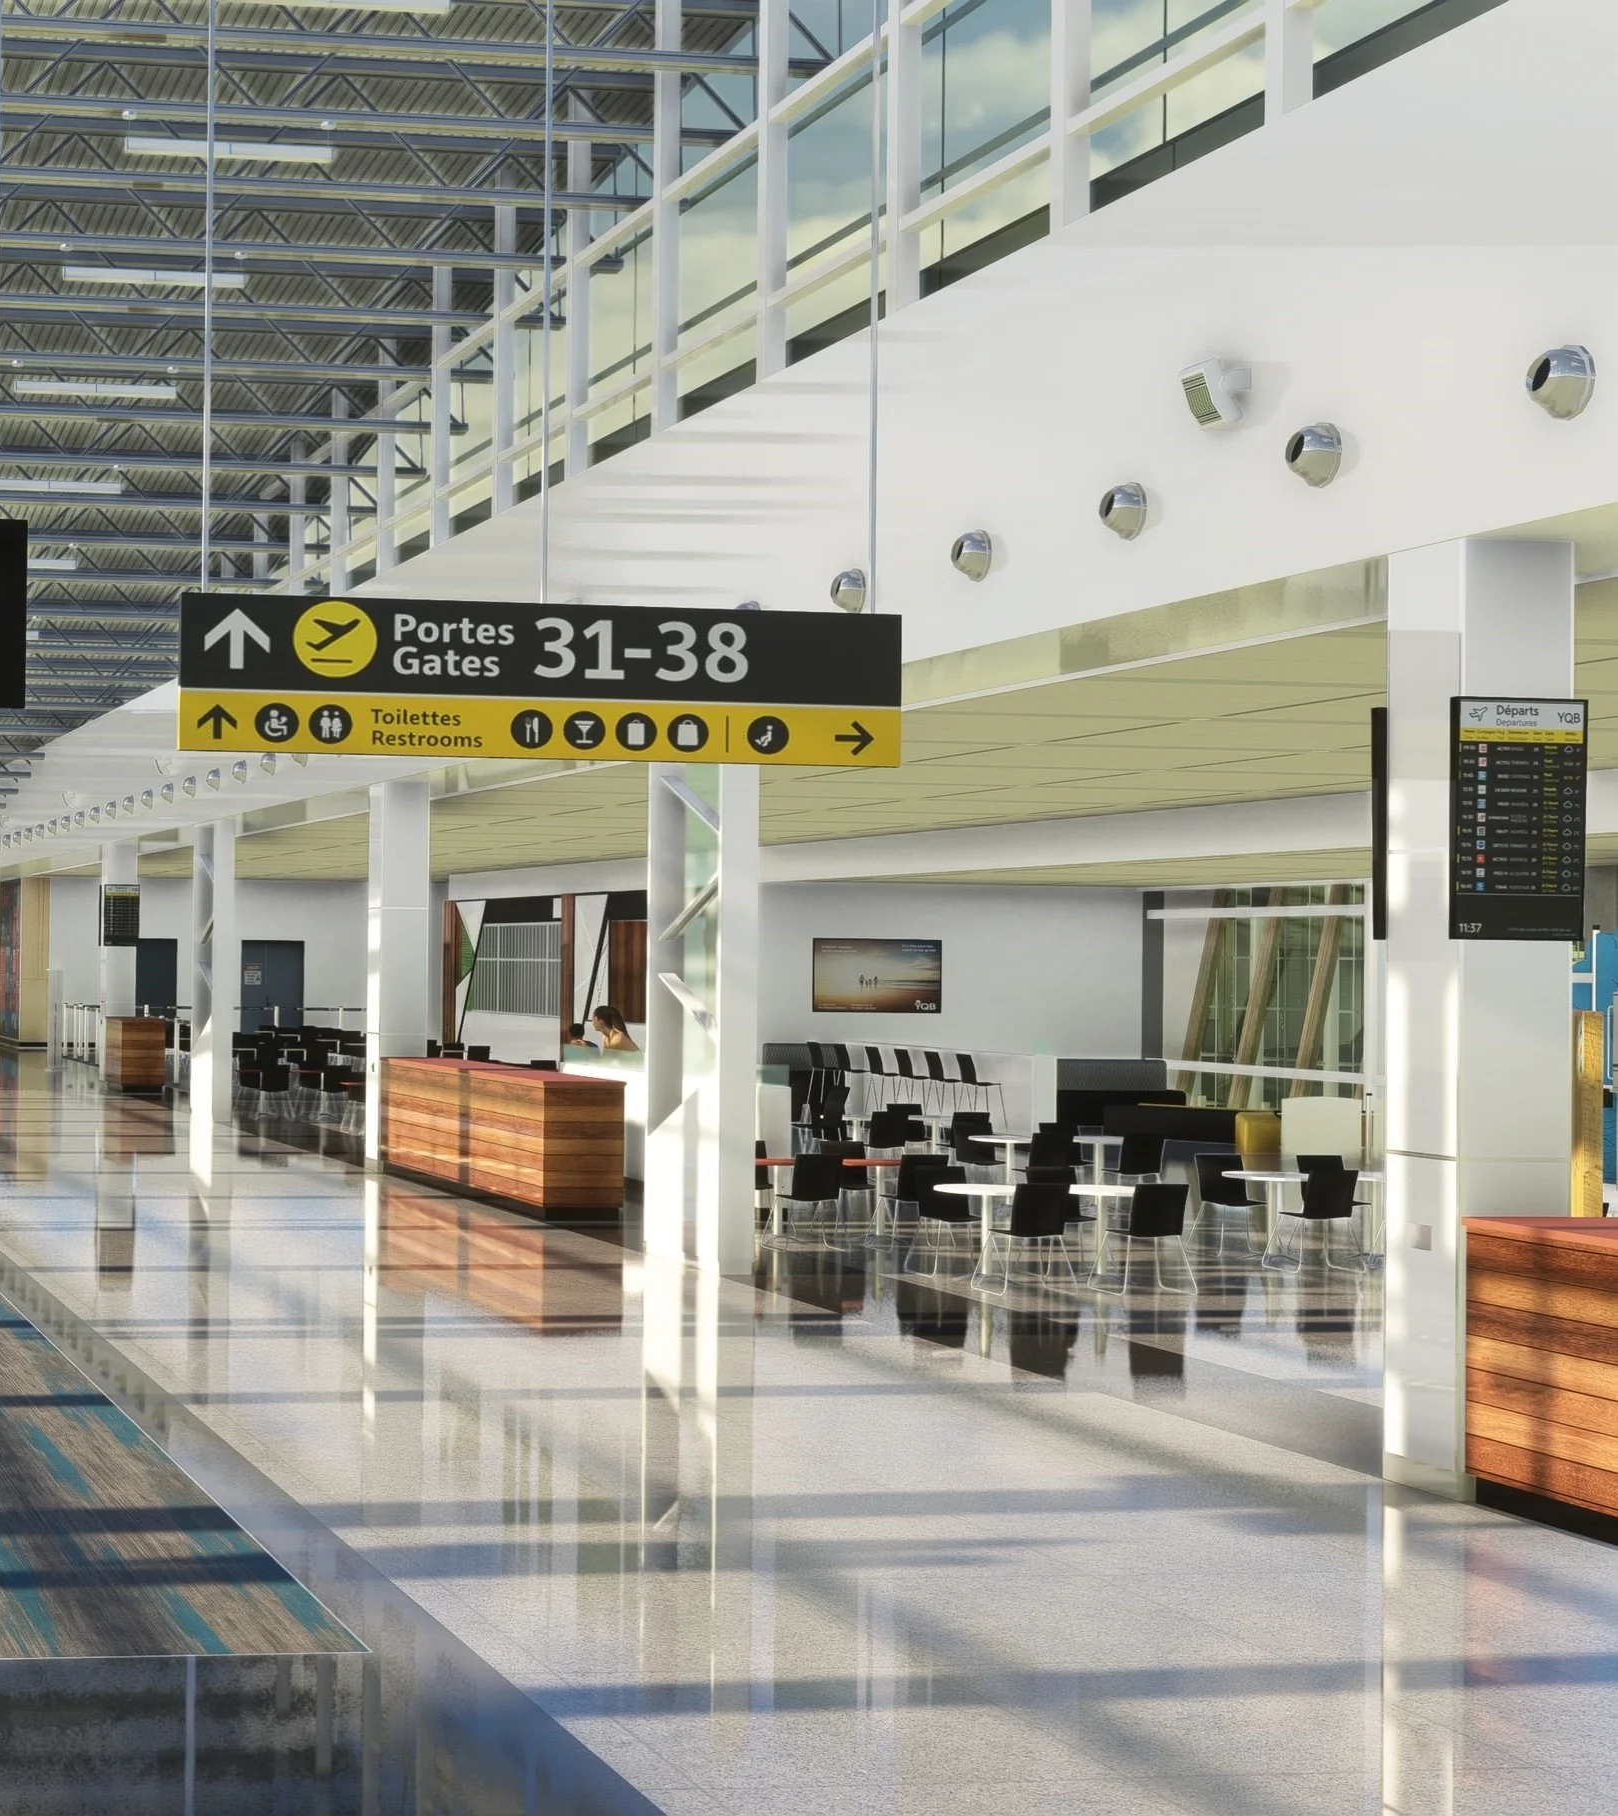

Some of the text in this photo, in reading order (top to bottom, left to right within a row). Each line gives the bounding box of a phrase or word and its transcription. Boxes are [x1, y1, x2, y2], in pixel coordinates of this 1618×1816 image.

[393, 612, 516, 646] Portes
[533, 617, 749, 683] 31-38
[392, 645, 501, 678] Gates
[370, 708, 463, 728] Toilettes
[1496, 704, 1540, 718] Départs
[1557, 712, 1582, 724] YQB
[370, 729, 483, 749] Restrooms
[1458, 923, 1483, 933] 11:37
[914, 1001, 937, 1011] YQB
